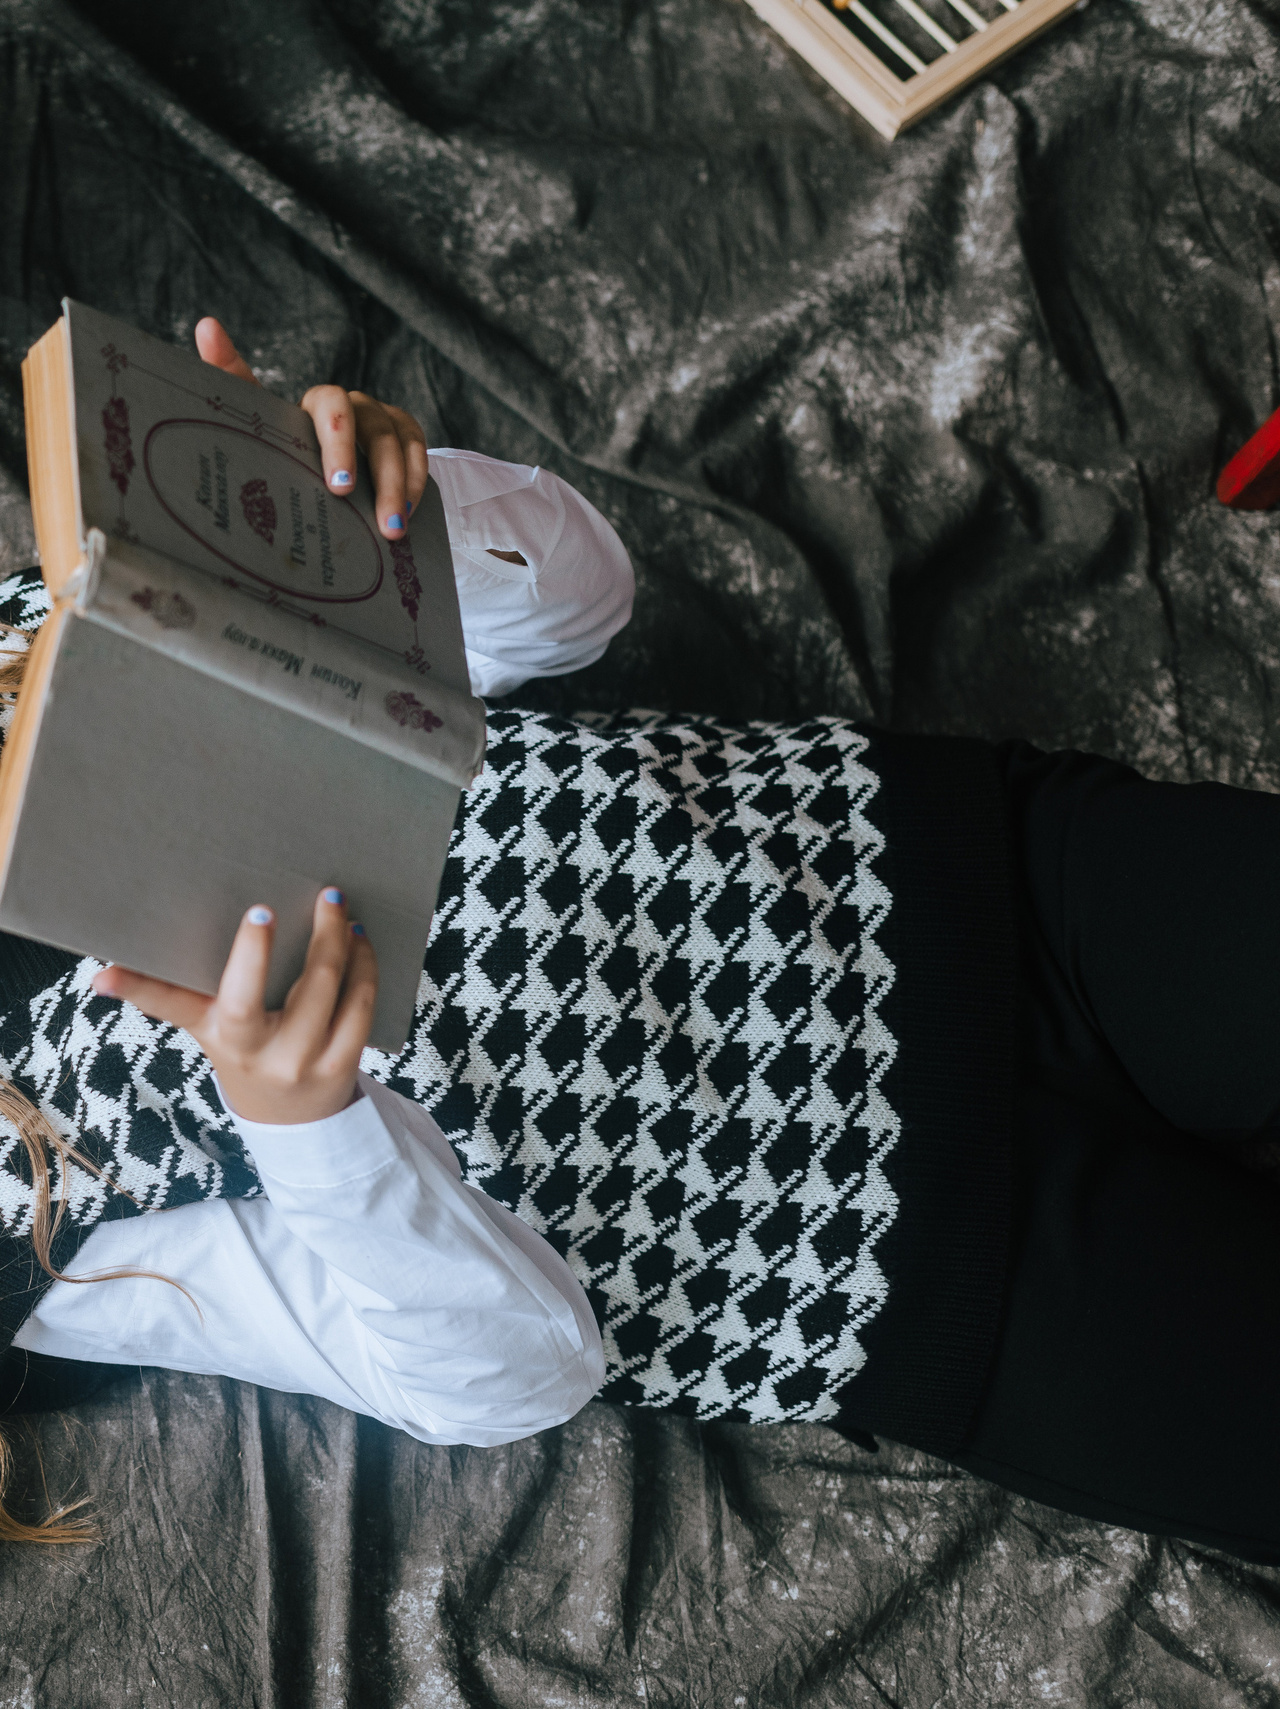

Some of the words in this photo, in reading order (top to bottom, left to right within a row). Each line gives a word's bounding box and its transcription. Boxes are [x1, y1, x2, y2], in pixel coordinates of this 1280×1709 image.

[196, 453, 214, 507] Колин
[213, 447, 231, 534] Маккалоу
[311, 662, 362, 699] Колин
